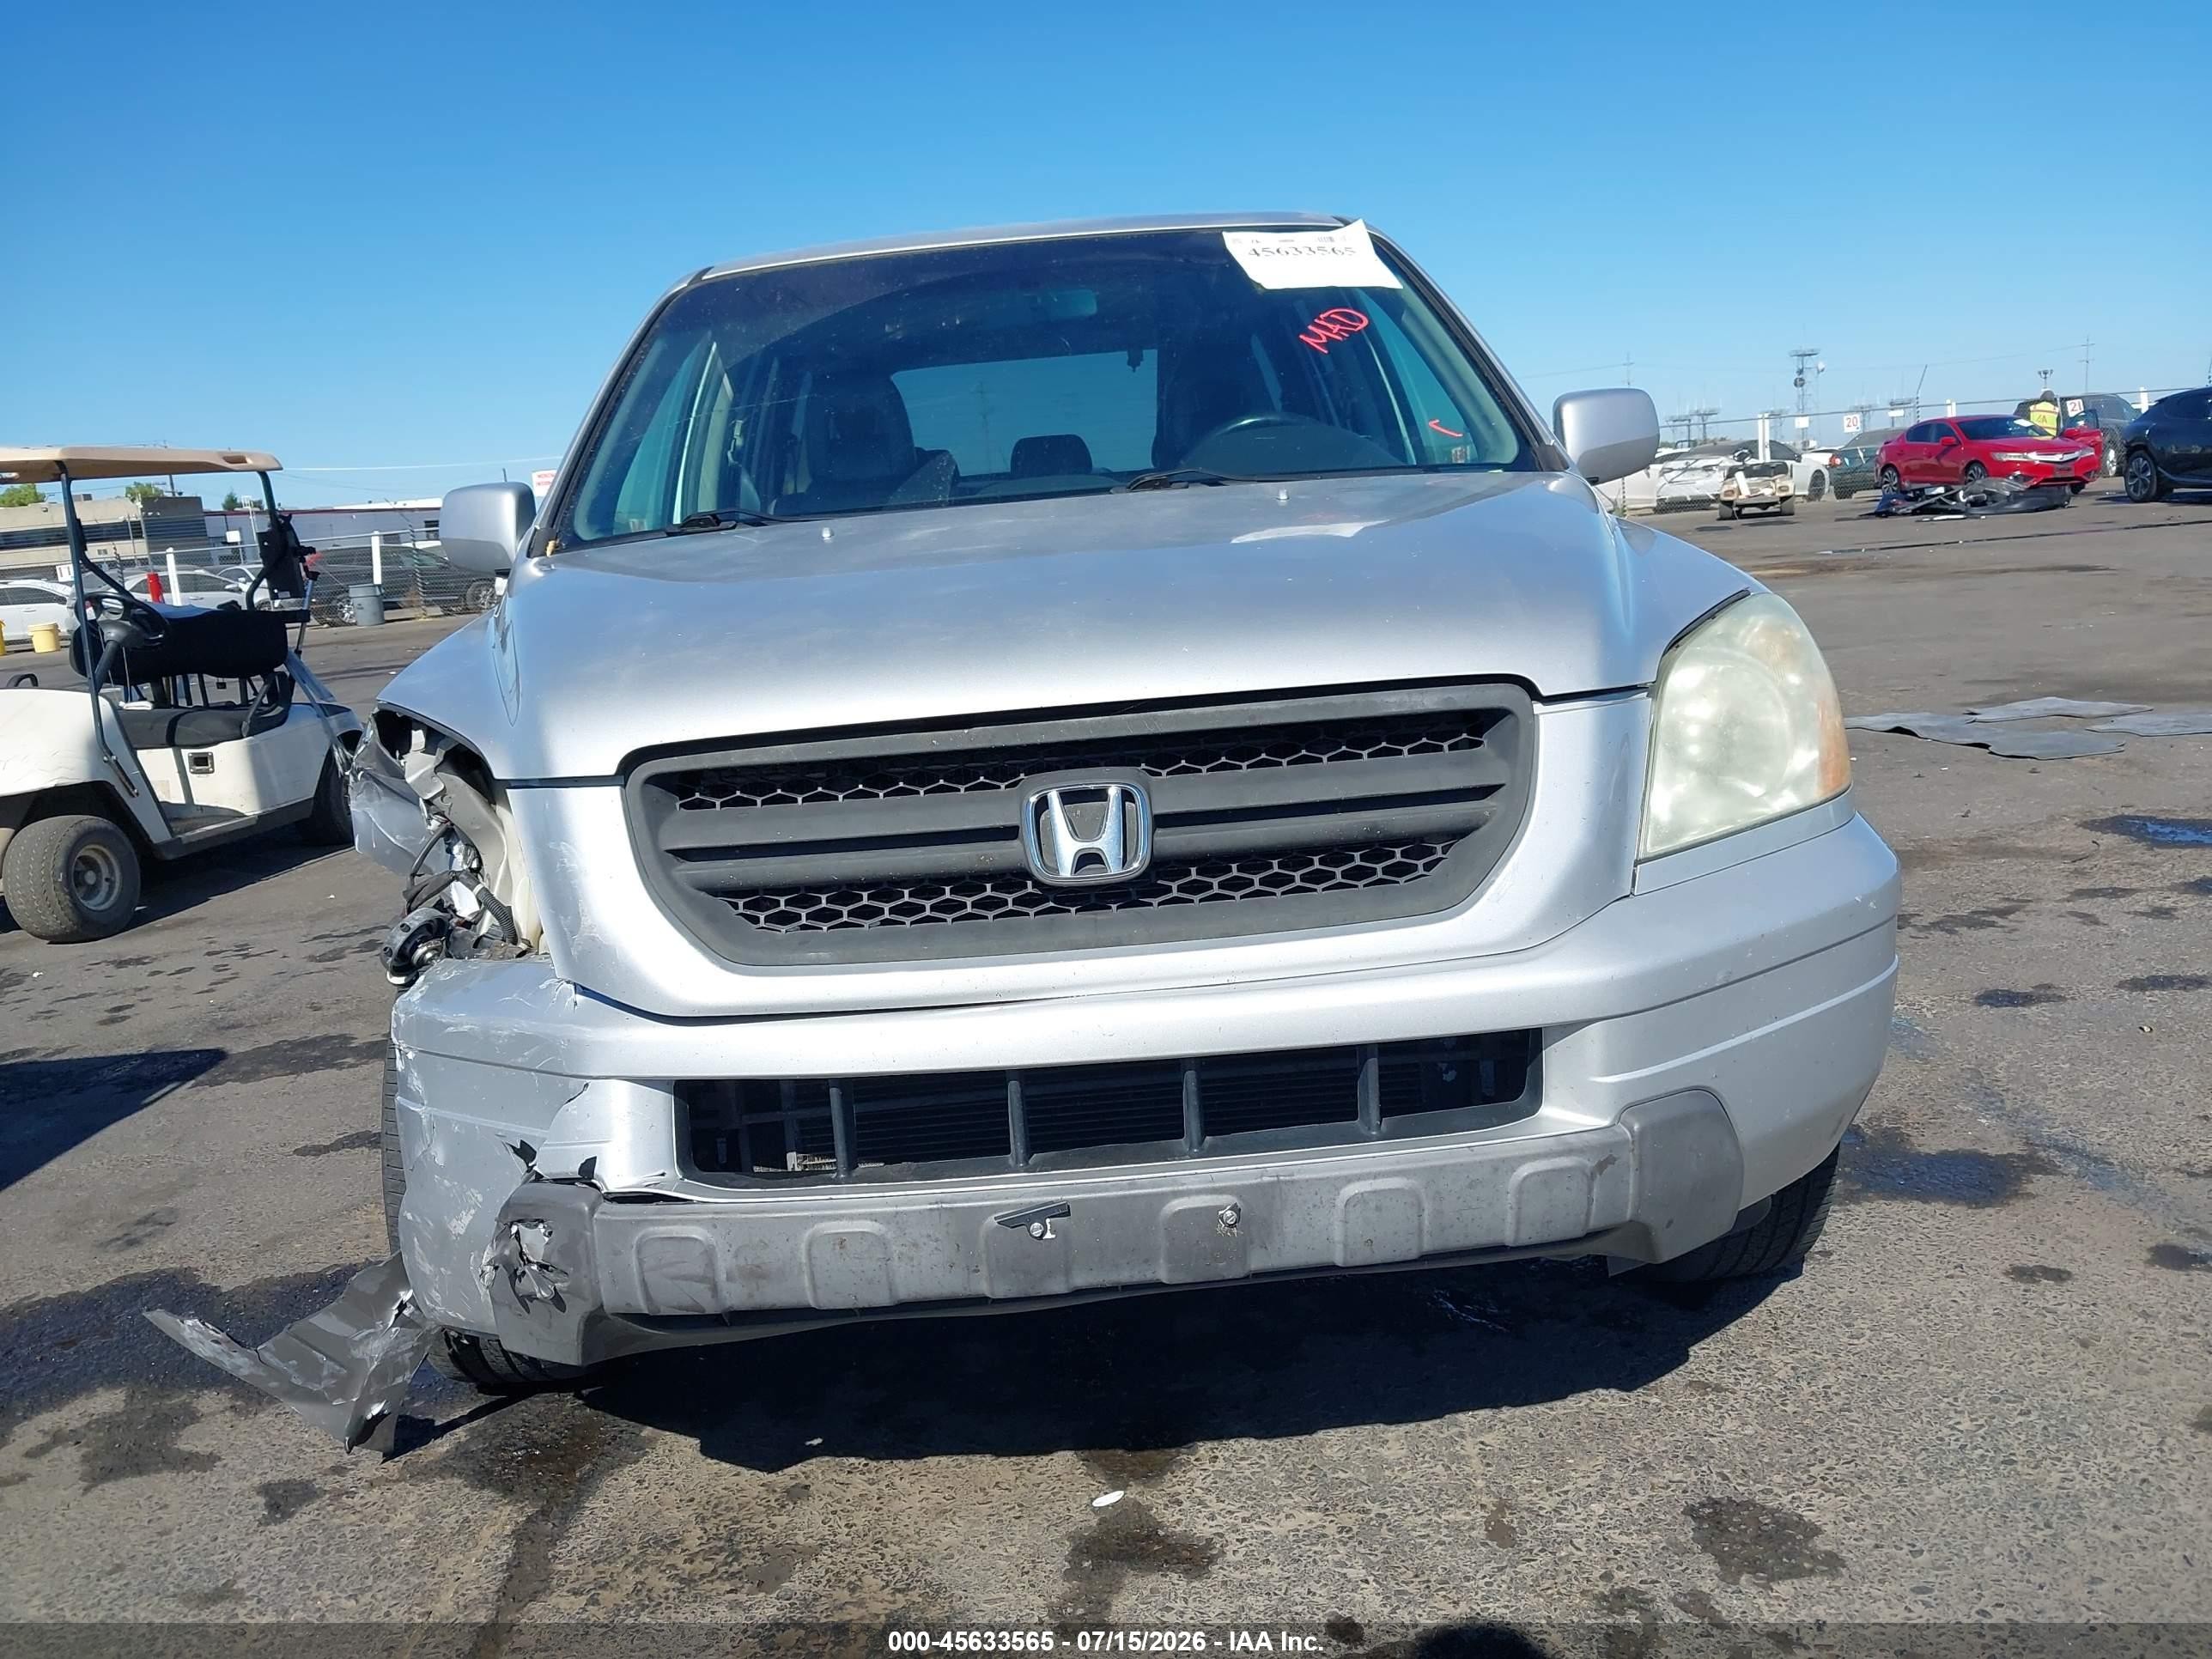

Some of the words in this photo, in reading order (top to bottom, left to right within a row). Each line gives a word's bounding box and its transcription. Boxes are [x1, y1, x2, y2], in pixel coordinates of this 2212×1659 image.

[1249, 245, 1357, 257] 45633565
[2069, 400, 2082, 412] 21
[1846, 416, 1858, 428] 20
